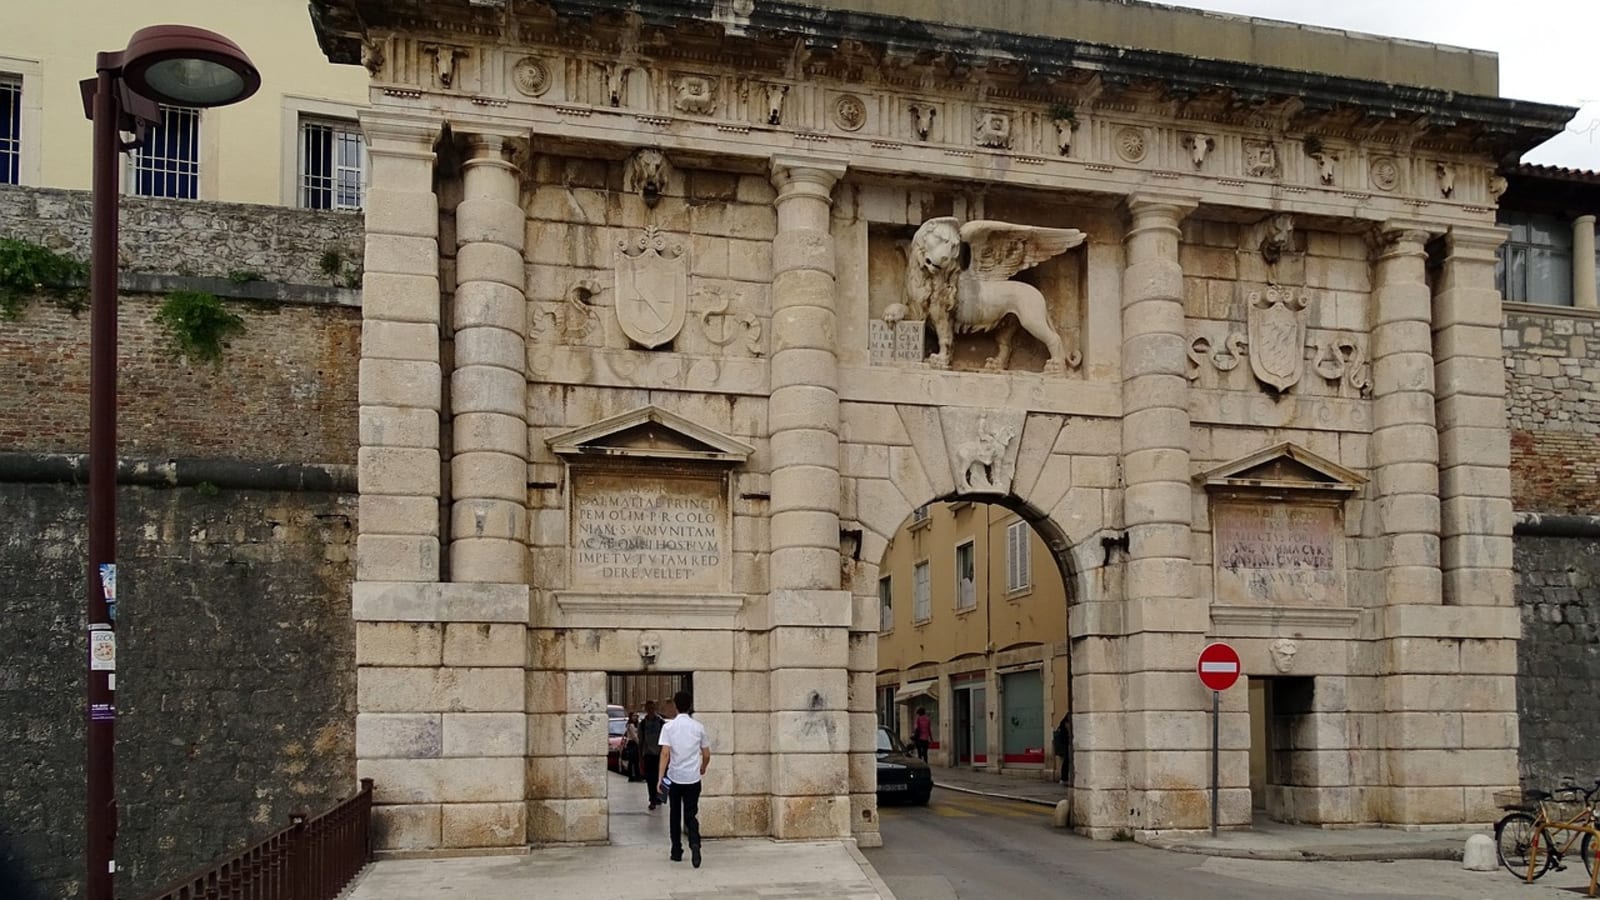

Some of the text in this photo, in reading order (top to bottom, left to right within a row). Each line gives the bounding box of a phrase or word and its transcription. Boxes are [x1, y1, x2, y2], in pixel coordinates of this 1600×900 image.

[579, 496, 663, 508] DALMATIAE
[580, 509, 605, 521] PEM
[609, 510, 644, 521] OLIM
[675, 512, 716, 523] COLO
[579, 552, 632, 564] IMPETV
[691, 555, 719, 567] RED
[602, 567, 639, 579] DERE
